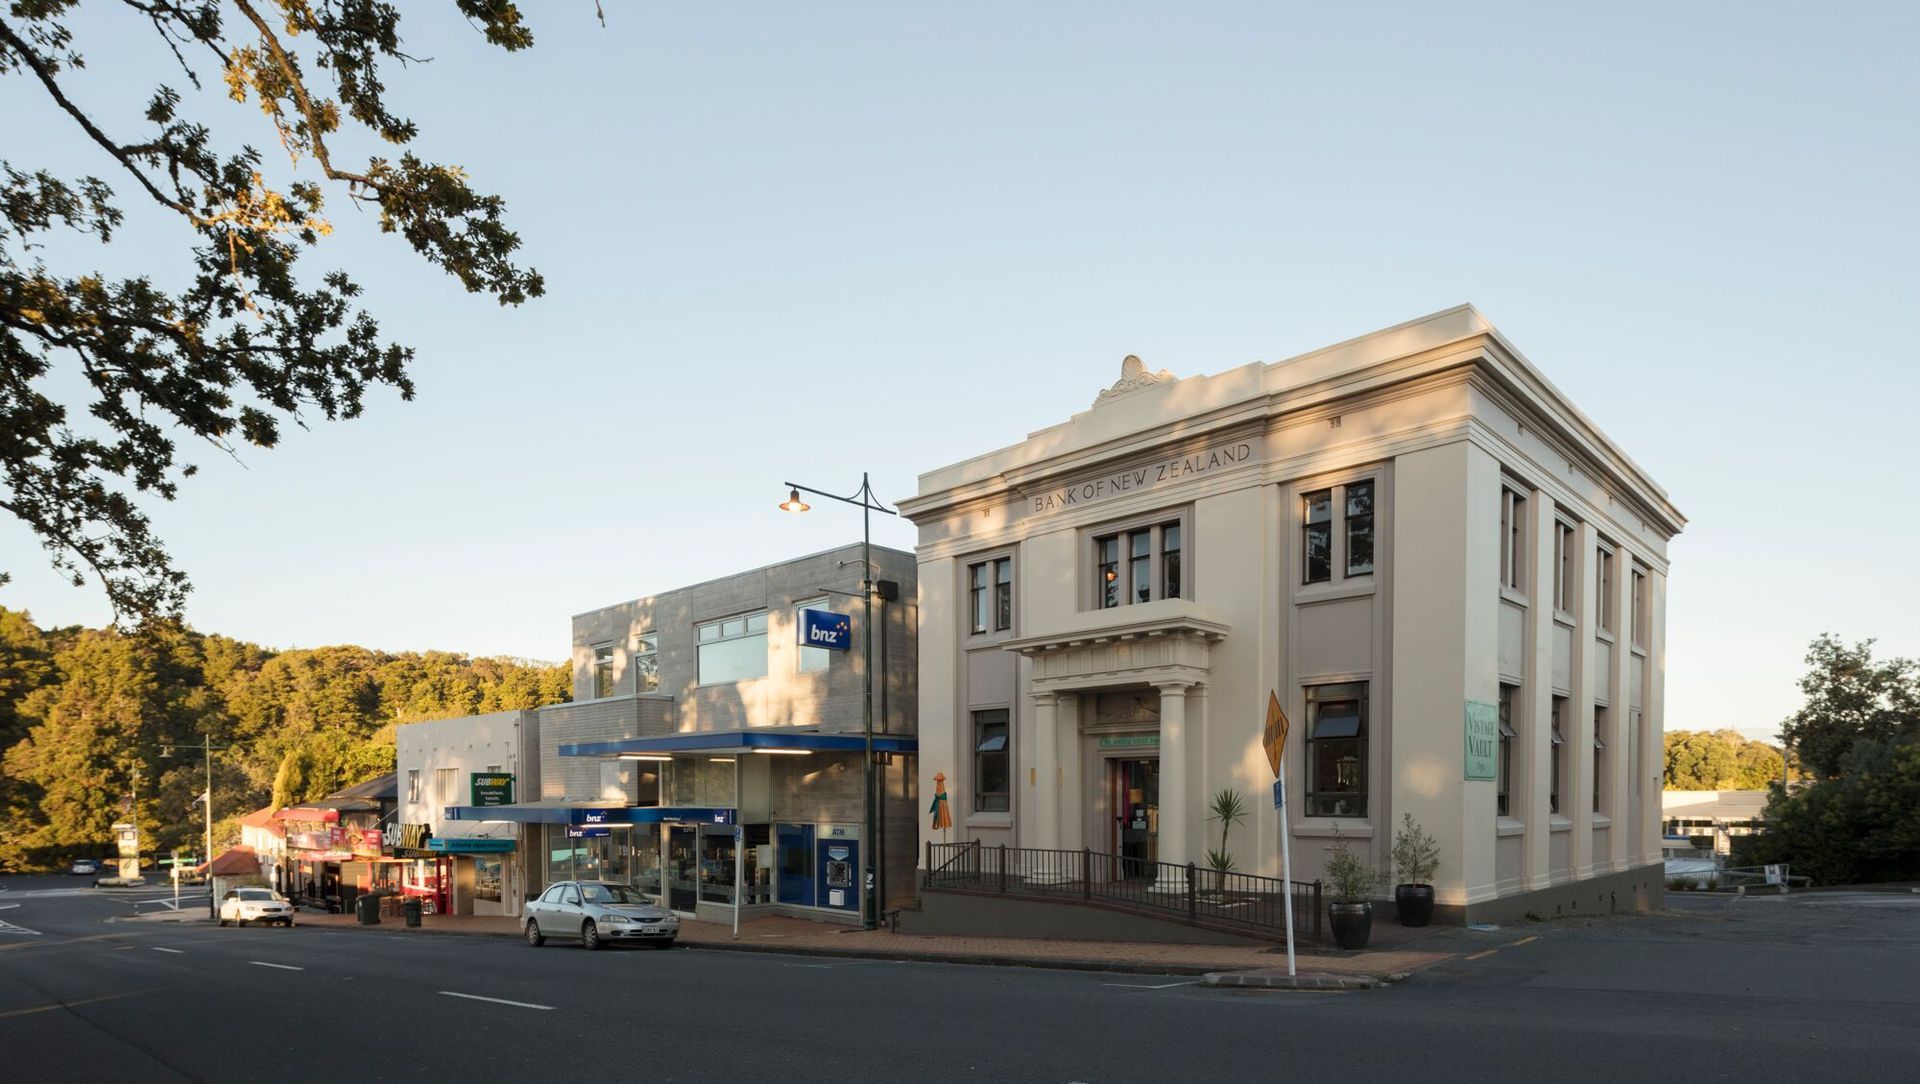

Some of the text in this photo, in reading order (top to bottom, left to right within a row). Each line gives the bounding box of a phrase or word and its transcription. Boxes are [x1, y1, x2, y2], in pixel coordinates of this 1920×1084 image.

[1035, 444, 1251, 512] BANK OF NEW ZEALAND
[810, 624, 838, 643] bnz
[1468, 736, 1493, 758] VAULT
[474, 777, 507, 786] SUBWAY
[586, 813, 602, 822] bnz
[384, 822, 425, 849] SUBWAY
[569, 829, 583, 837] bnz
[831, 828, 846, 836] ATM
